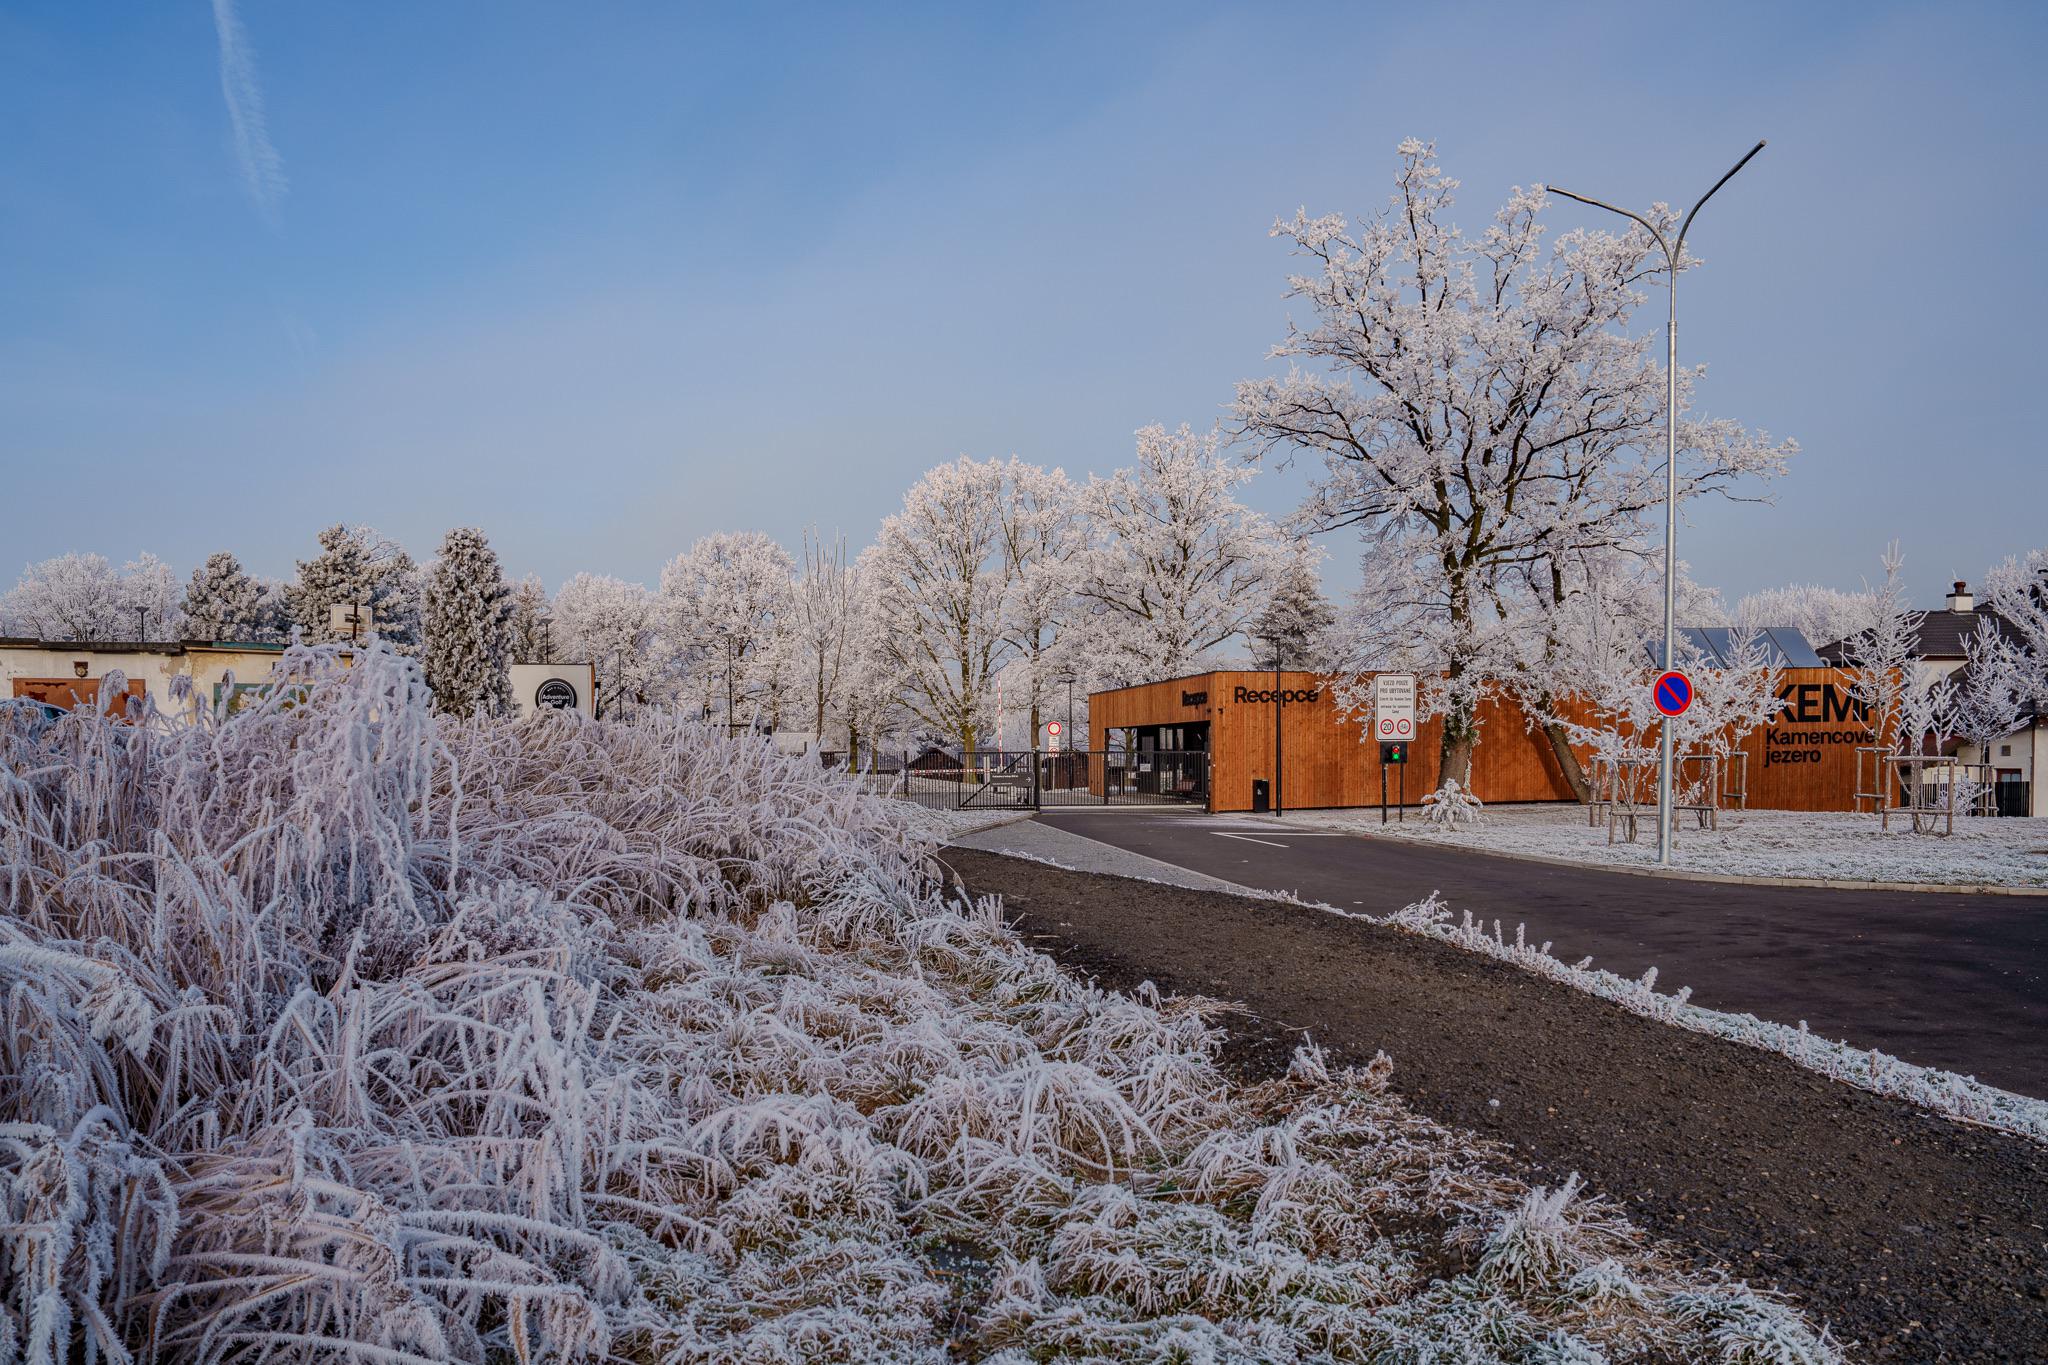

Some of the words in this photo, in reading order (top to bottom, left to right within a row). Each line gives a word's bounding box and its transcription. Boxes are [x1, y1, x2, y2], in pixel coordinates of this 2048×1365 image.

[1234, 686, 1319, 707] Recepce
[1383, 722, 1392, 731] 20
[1766, 726, 1876, 745] Kamencové
[1764, 746, 1822, 768] jezero
